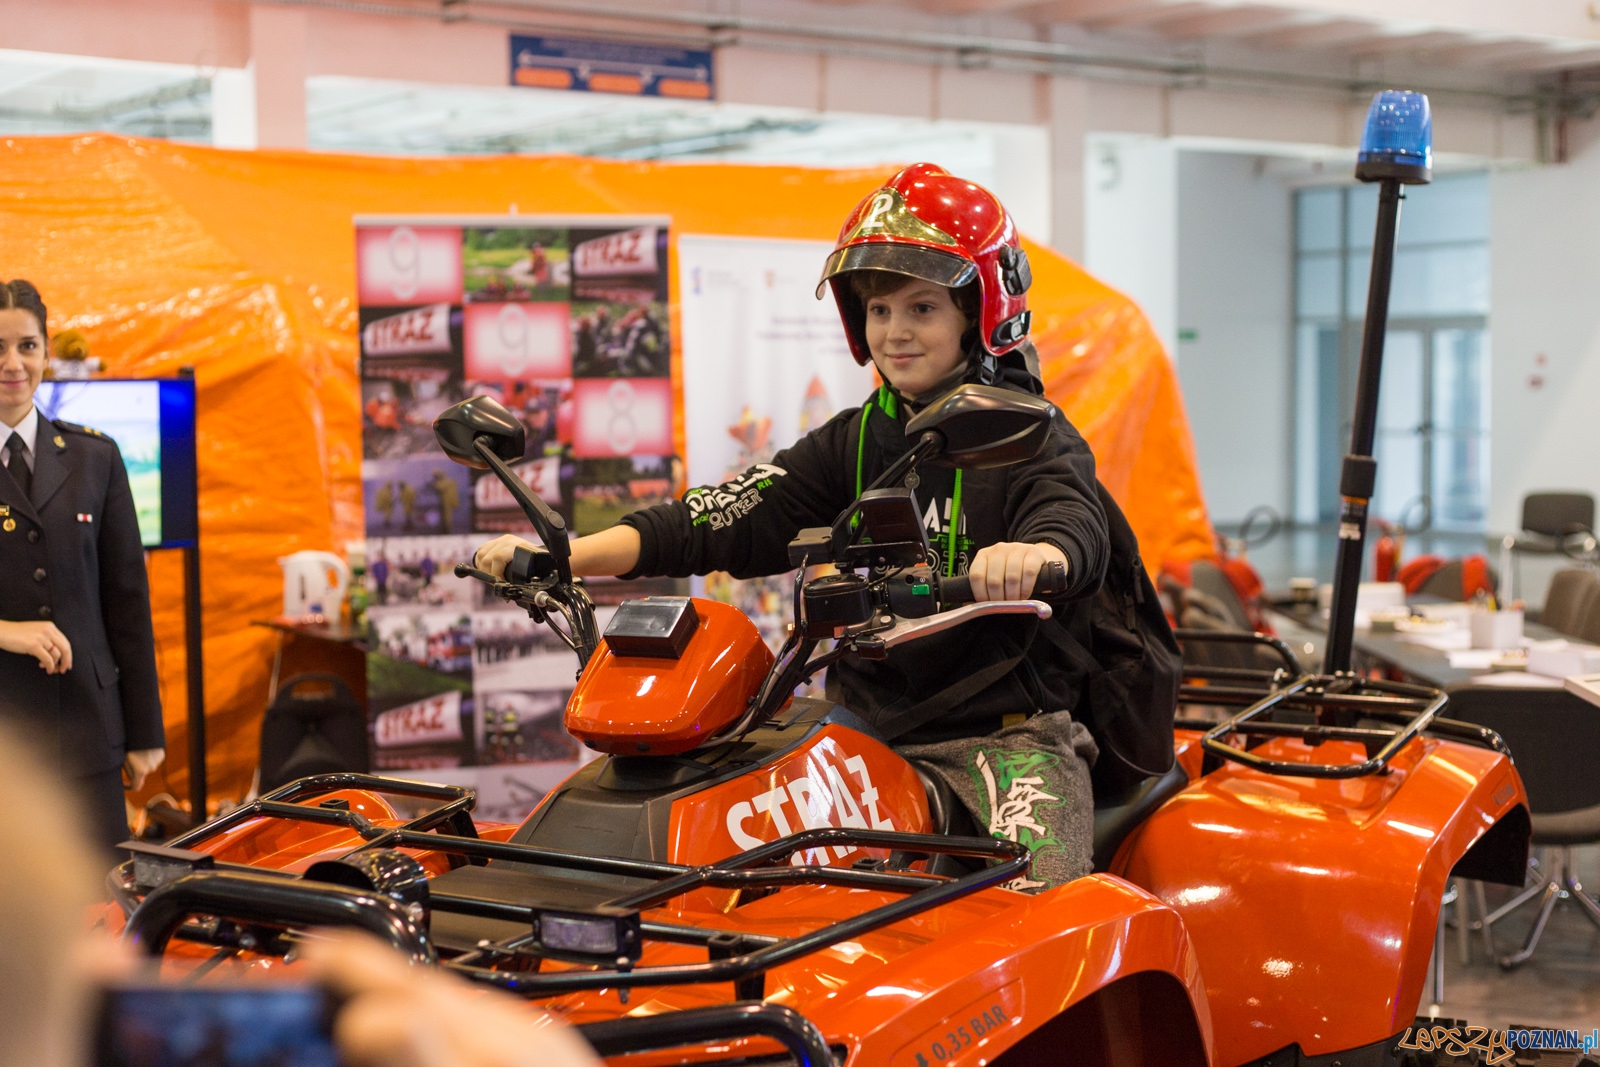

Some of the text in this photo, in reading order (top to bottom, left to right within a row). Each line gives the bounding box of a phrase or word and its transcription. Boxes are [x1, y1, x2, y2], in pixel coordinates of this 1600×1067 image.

[861, 193, 894, 229] 2
[388, 226, 421, 300] 9
[498, 303, 530, 376] 9
[607, 380, 638, 454] 8
[931, 1005, 1008, 1061] 0,35 BAR
